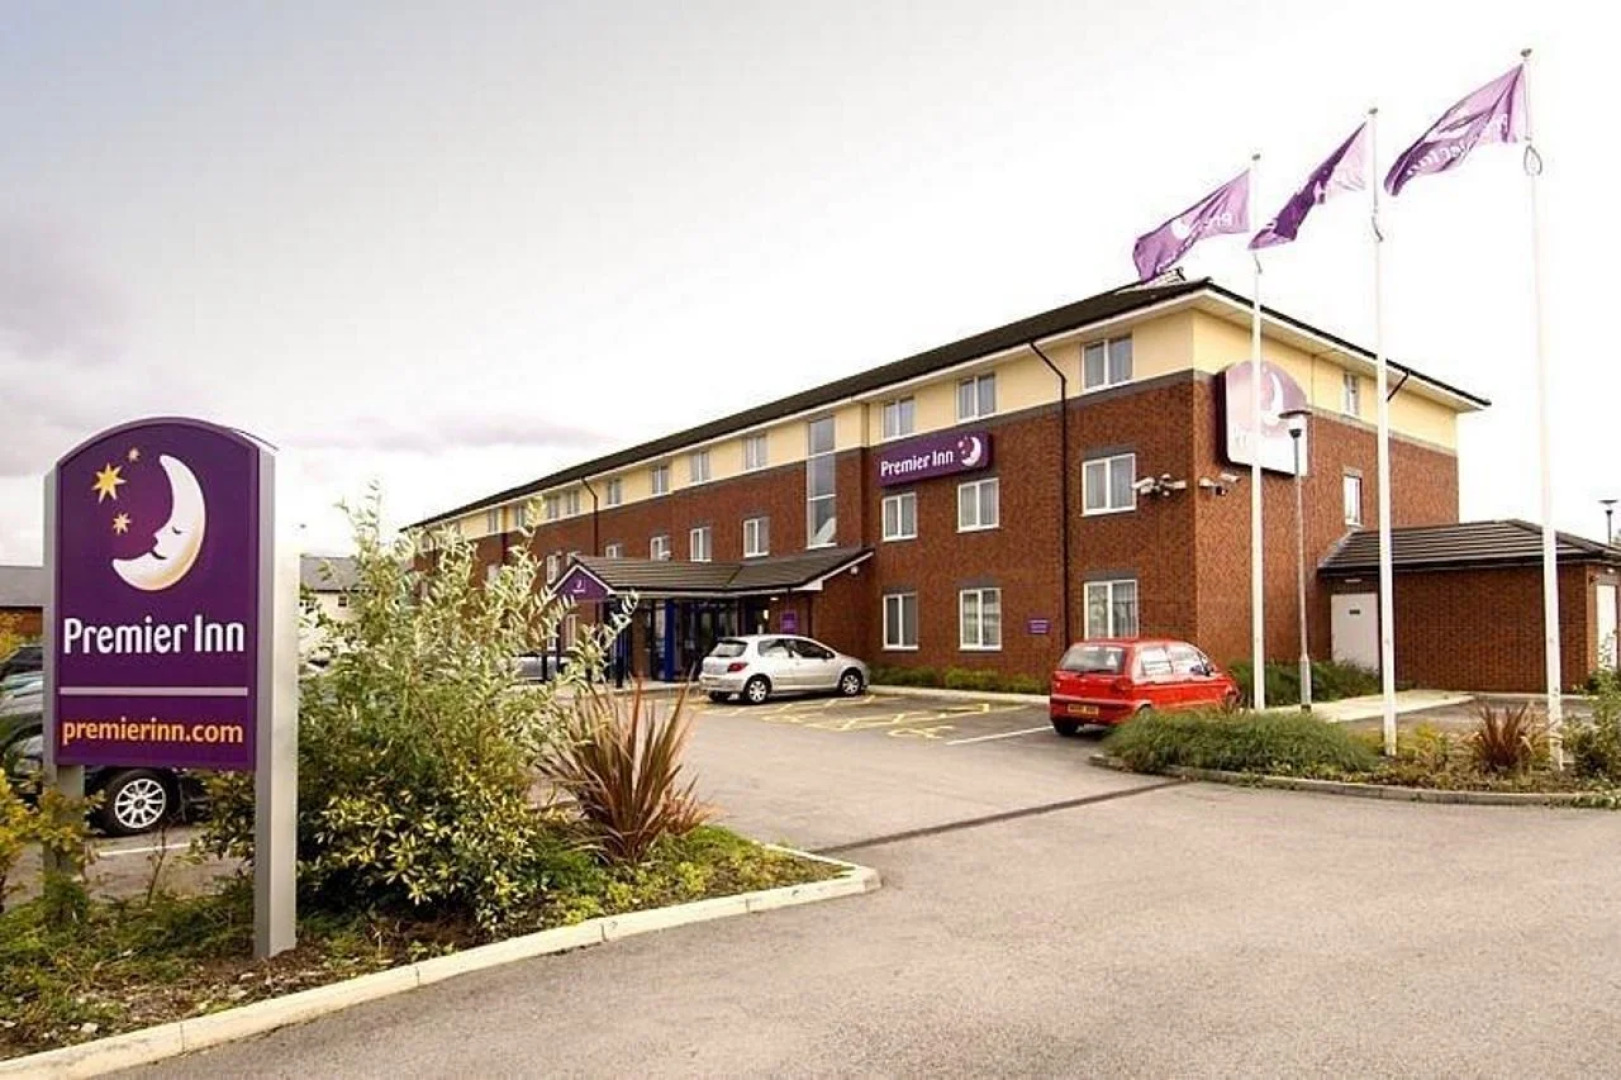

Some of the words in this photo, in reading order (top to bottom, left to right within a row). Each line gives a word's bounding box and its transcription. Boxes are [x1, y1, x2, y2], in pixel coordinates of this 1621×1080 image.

[880, 455, 931, 477] Premier
[932, 450, 954, 467] Inn
[63, 615, 188, 654] Premier
[194, 614, 244, 652] Inn
[62, 716, 243, 746] premierinn.com
